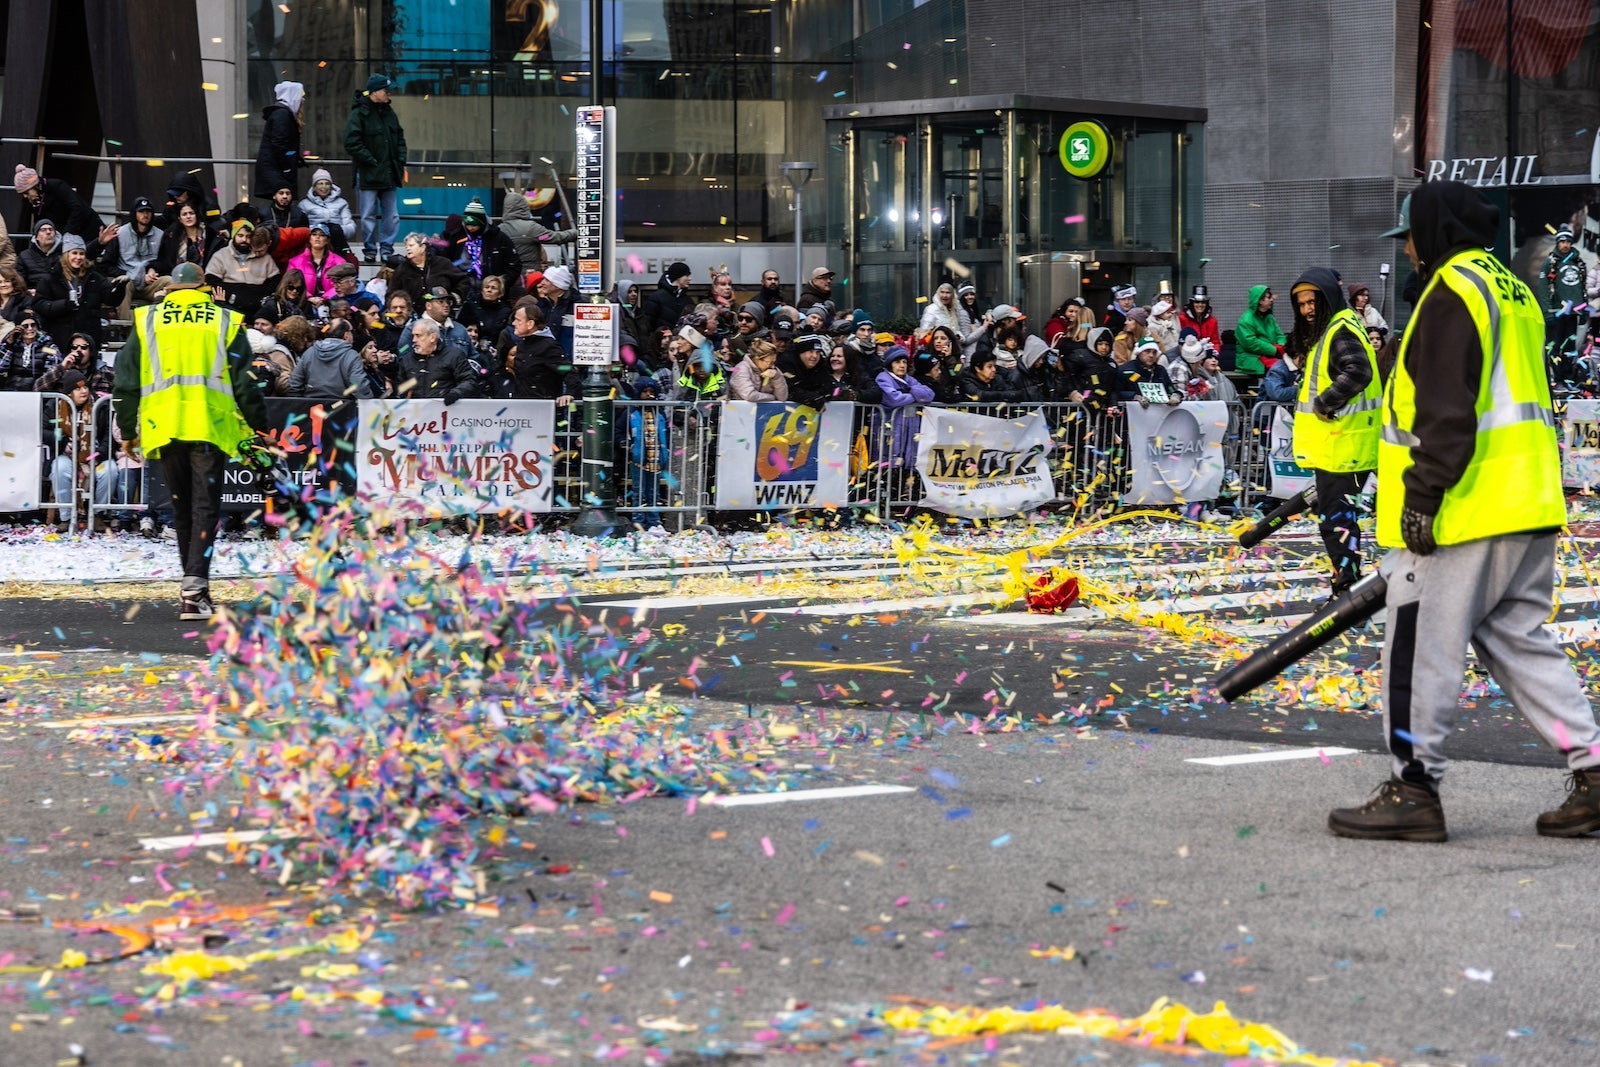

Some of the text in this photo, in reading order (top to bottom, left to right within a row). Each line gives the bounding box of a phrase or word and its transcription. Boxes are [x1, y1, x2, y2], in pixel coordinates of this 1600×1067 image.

[1427, 155, 1542, 187] RETAIL
[163, 300, 216, 311] RE
[163, 310, 215, 324] STAFF
[1139, 383, 1162, 391] RUN
[383, 411, 448, 440] Live!
[451, 418, 533, 429] CASINO HOTEL
[756, 404, 819, 482] 69
[1148, 440, 1206, 456] NISSAN
